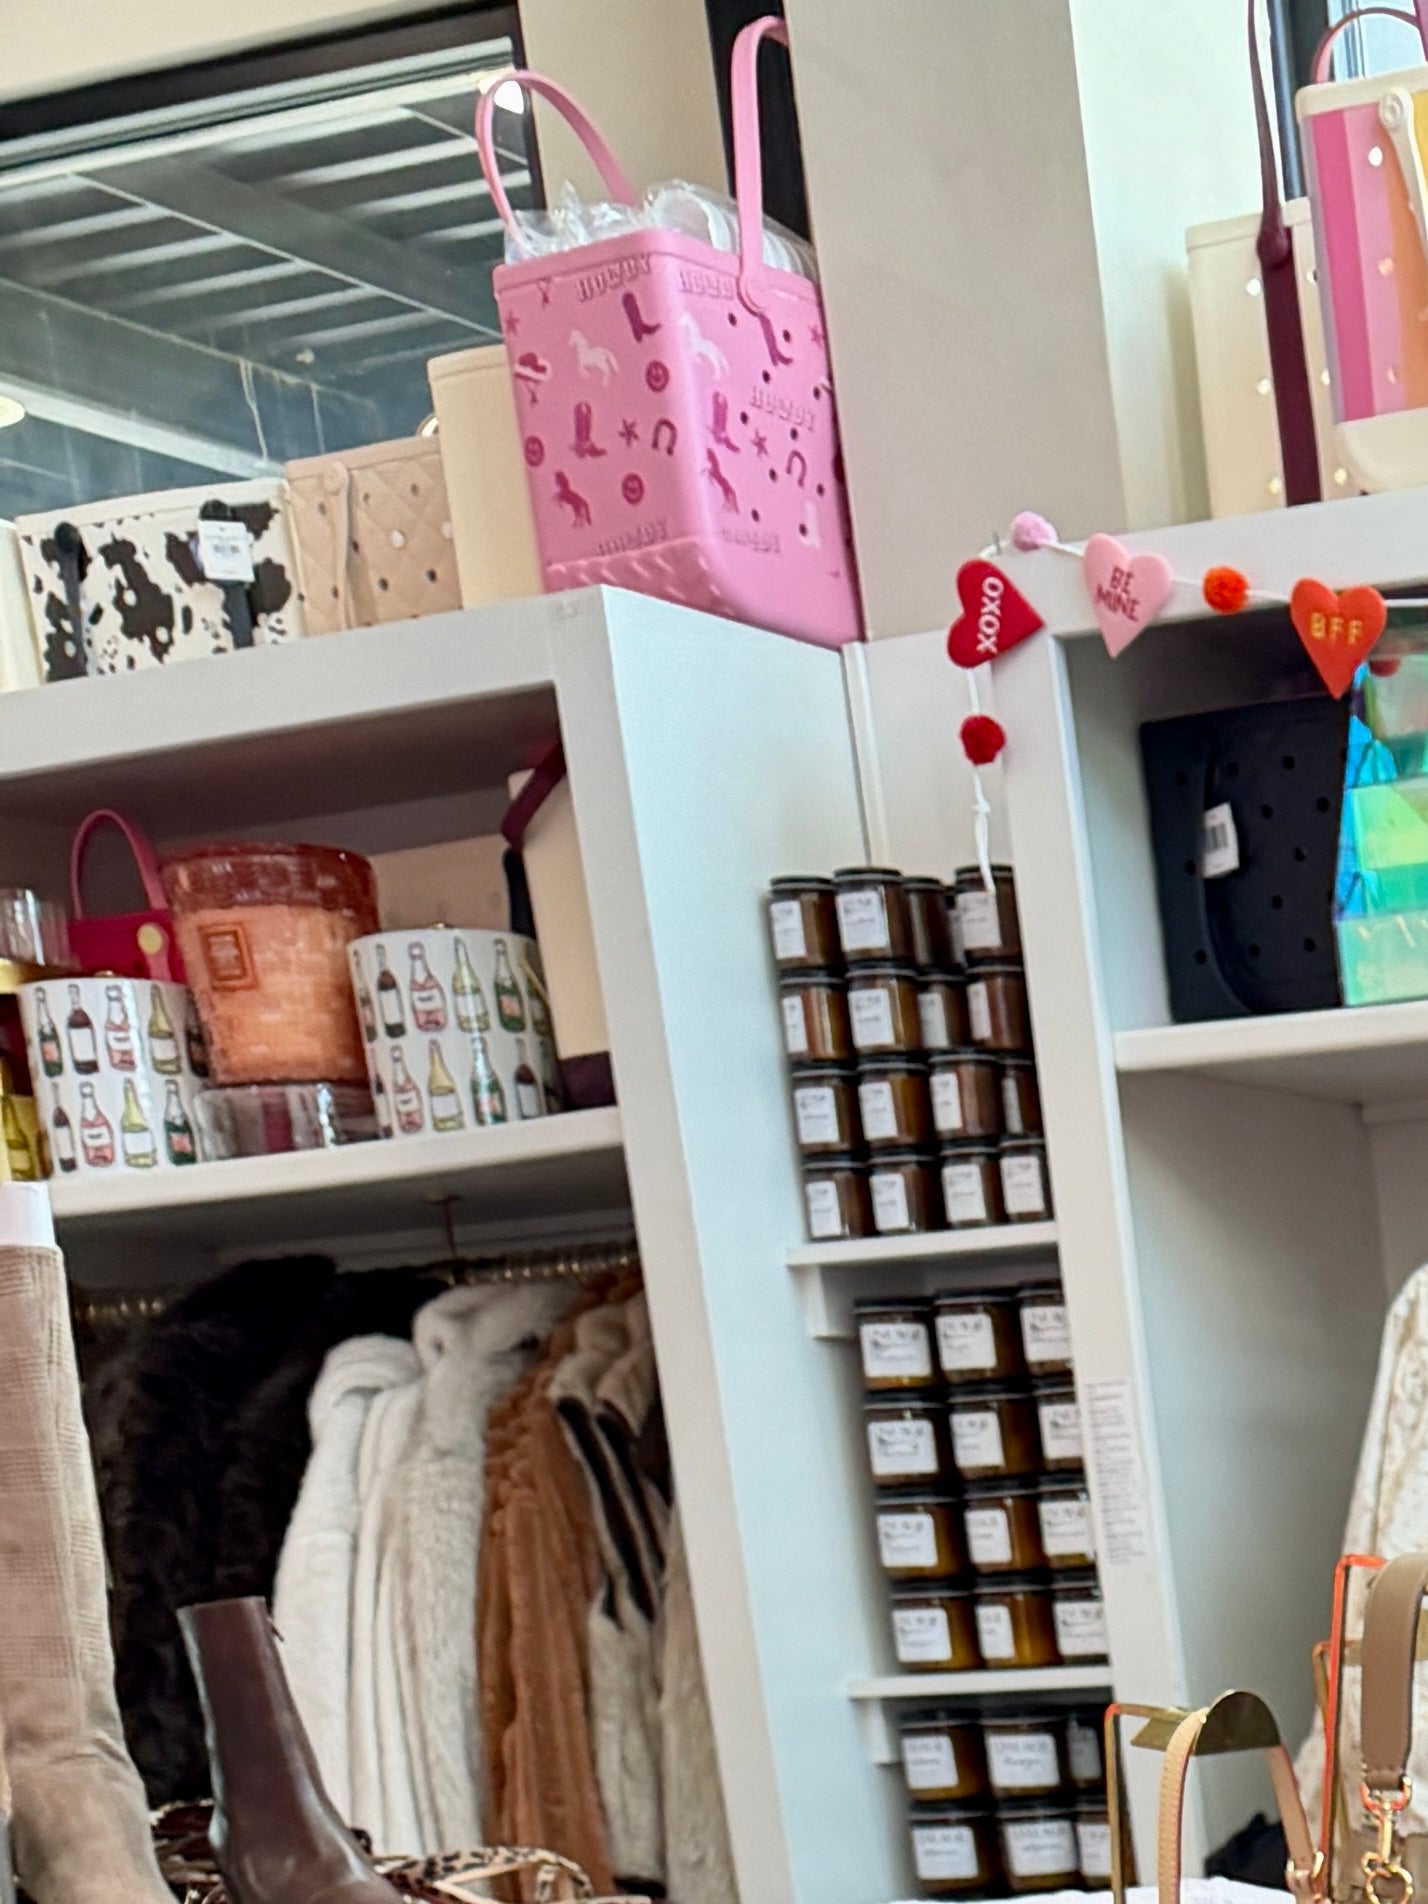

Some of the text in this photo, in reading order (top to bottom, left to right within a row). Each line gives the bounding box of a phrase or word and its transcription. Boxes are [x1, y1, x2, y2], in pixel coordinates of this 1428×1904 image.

[1111, 566, 1135, 593] BE
[976, 577, 1004, 654] XOXO
[1096, 584, 1139, 622] MINE
[1310, 612, 1364, 643] BFF
